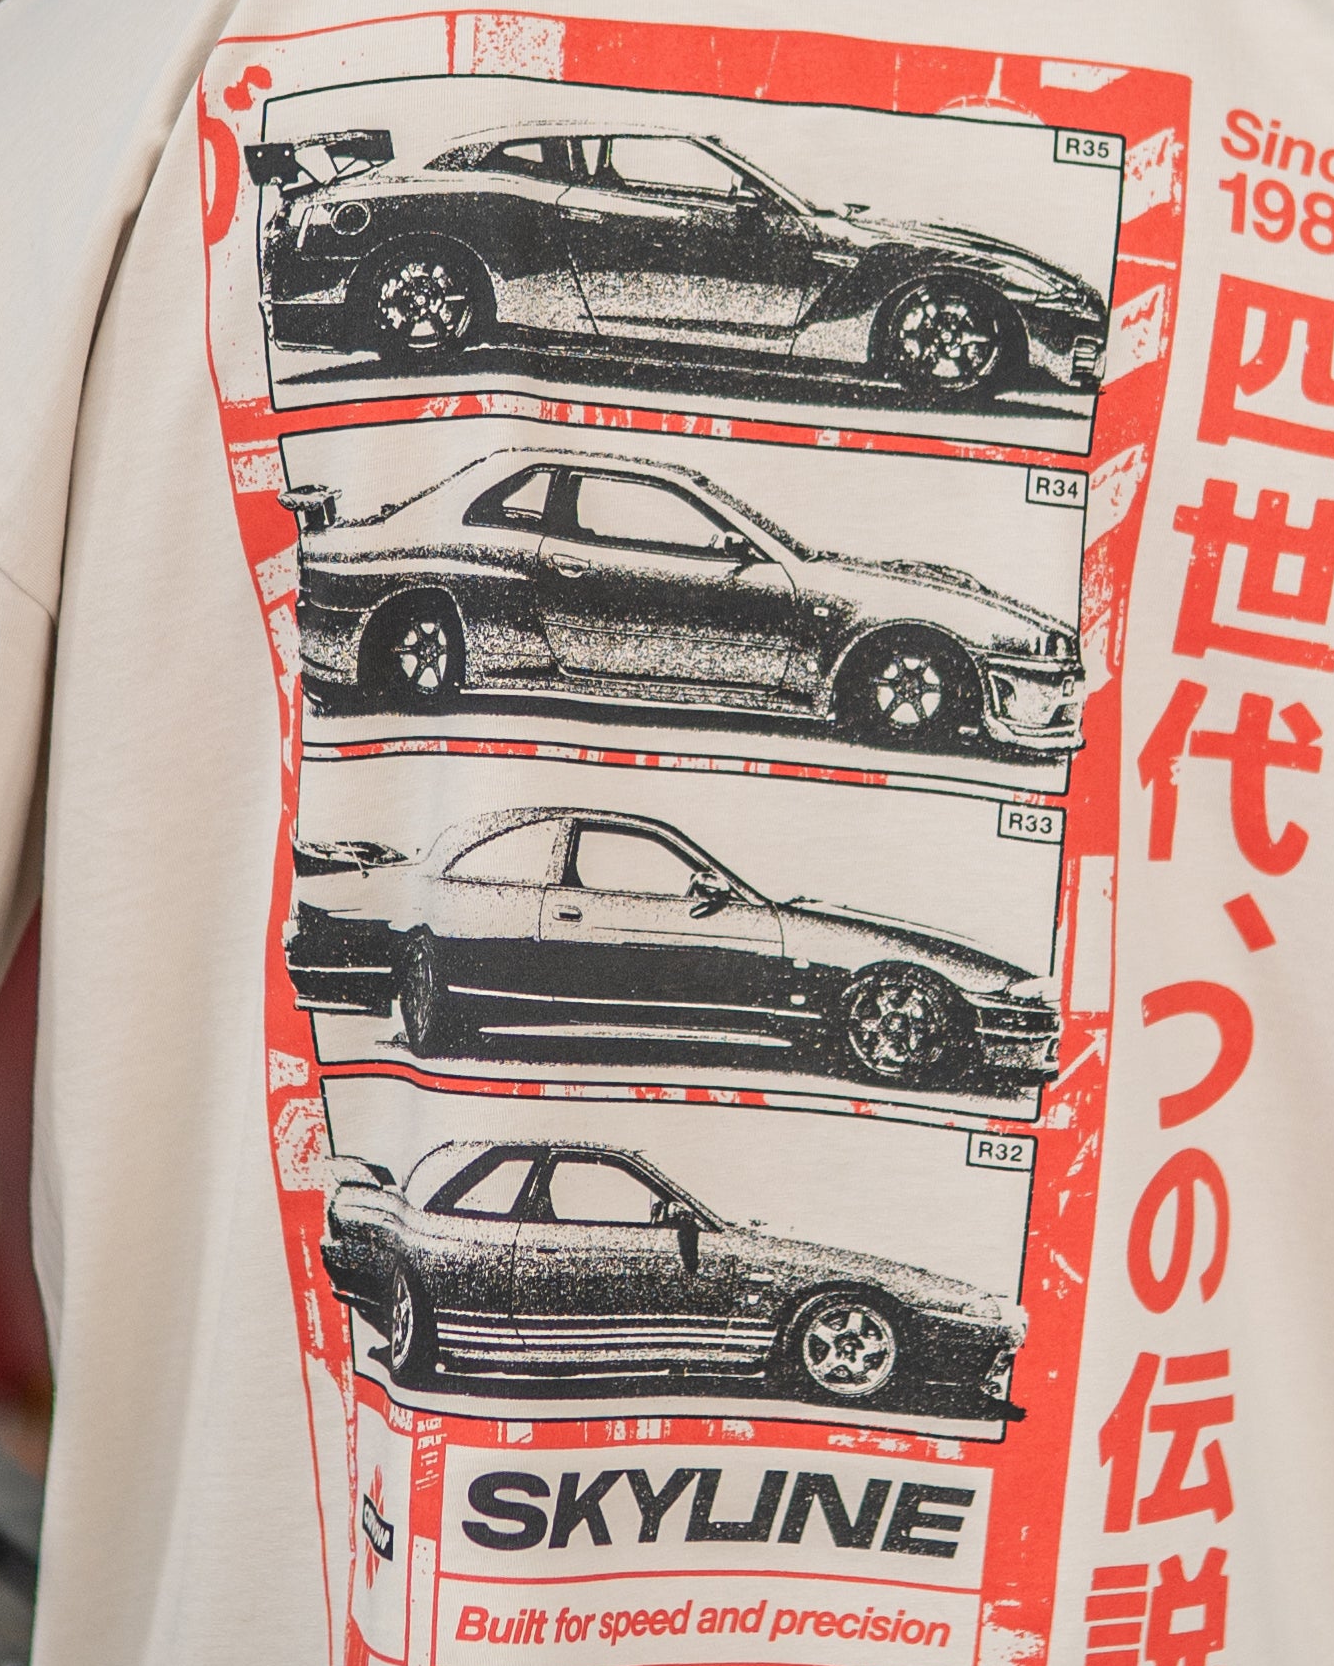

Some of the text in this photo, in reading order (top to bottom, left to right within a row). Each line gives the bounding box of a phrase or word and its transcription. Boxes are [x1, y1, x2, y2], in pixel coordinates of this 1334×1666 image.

[1066, 137, 1109, 158] R35
[1036, 476, 1079, 499] R34
[1009, 812, 1053, 834] R33
[978, 1141, 1023, 1162] R32
[461, 1467, 976, 1559] SKYLINE
[454, 1599, 952, 1648] Built for speed and precision
